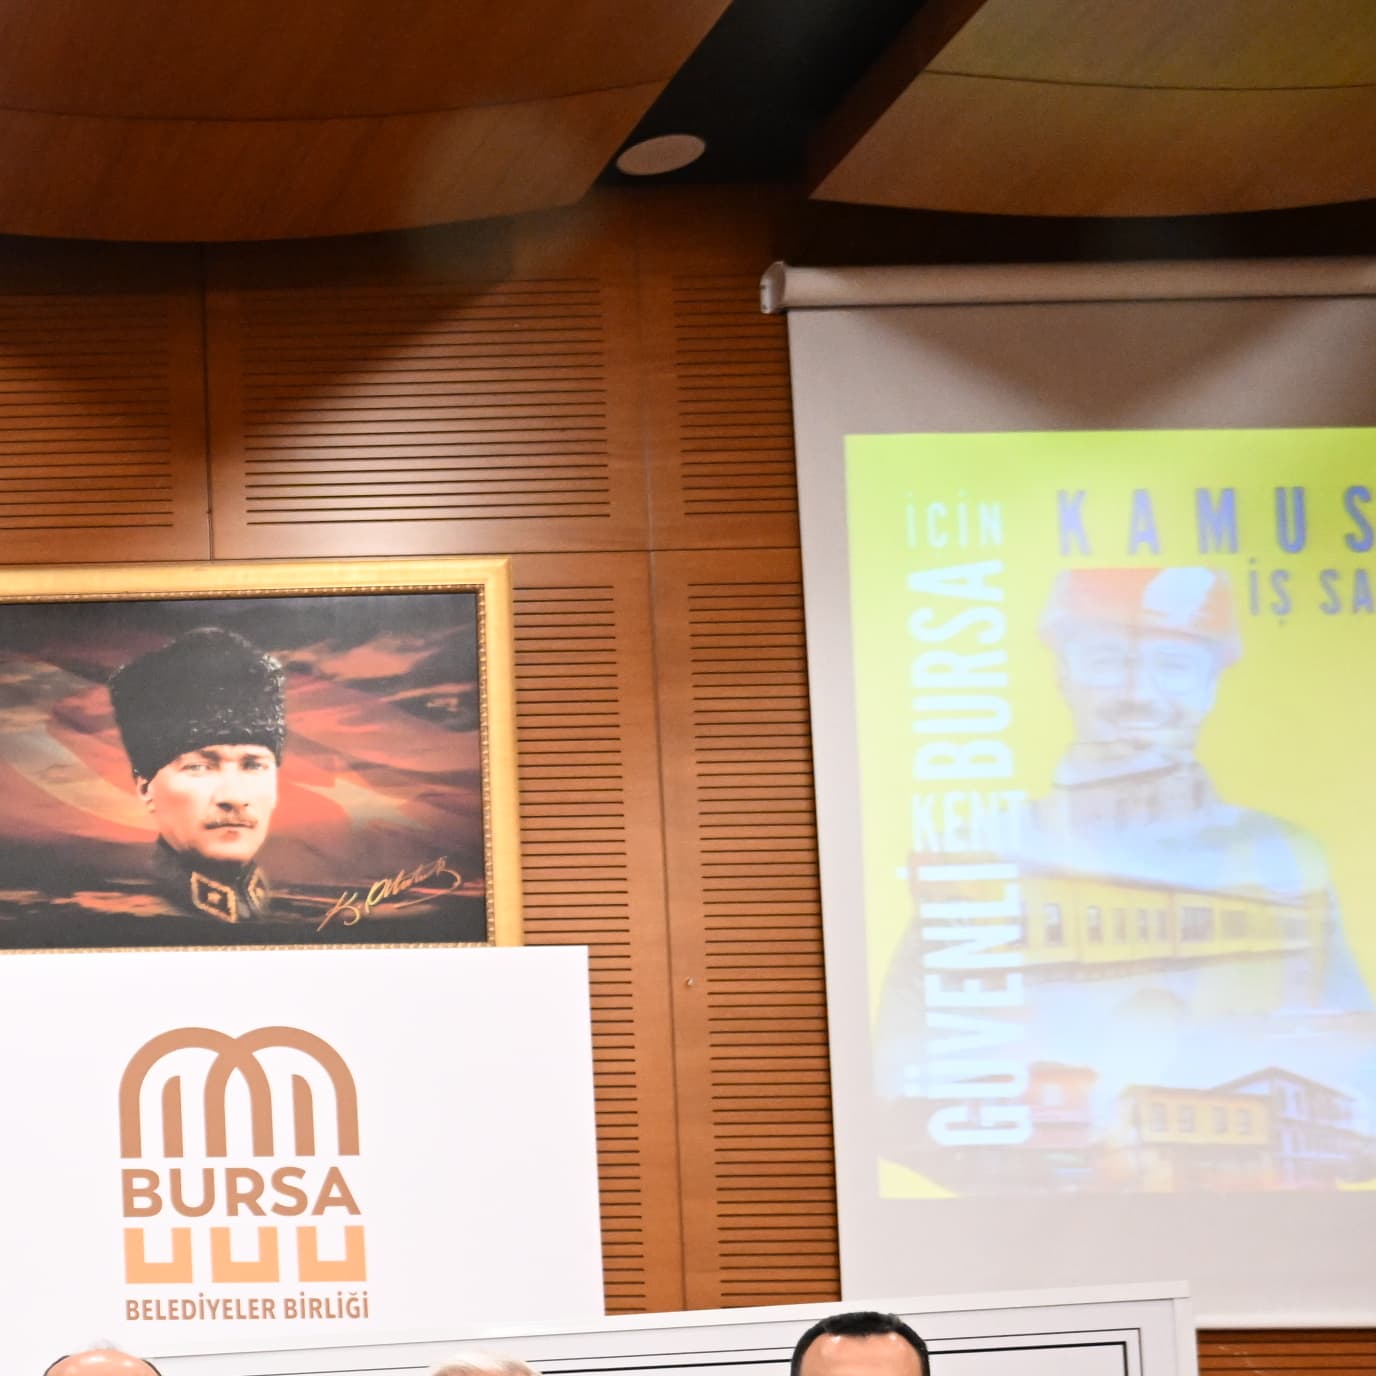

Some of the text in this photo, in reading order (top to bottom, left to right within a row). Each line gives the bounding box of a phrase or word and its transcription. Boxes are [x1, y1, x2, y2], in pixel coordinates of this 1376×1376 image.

[905, 489, 1005, 558] İÇİN
[906, 559, 1014, 781] BURSA
[897, 858, 1032, 1146] GÜVENLİ
[121, 1166, 362, 1218] BURSA
[125, 1291, 369, 1321] BELEDİYELER BİRLİĞİ
